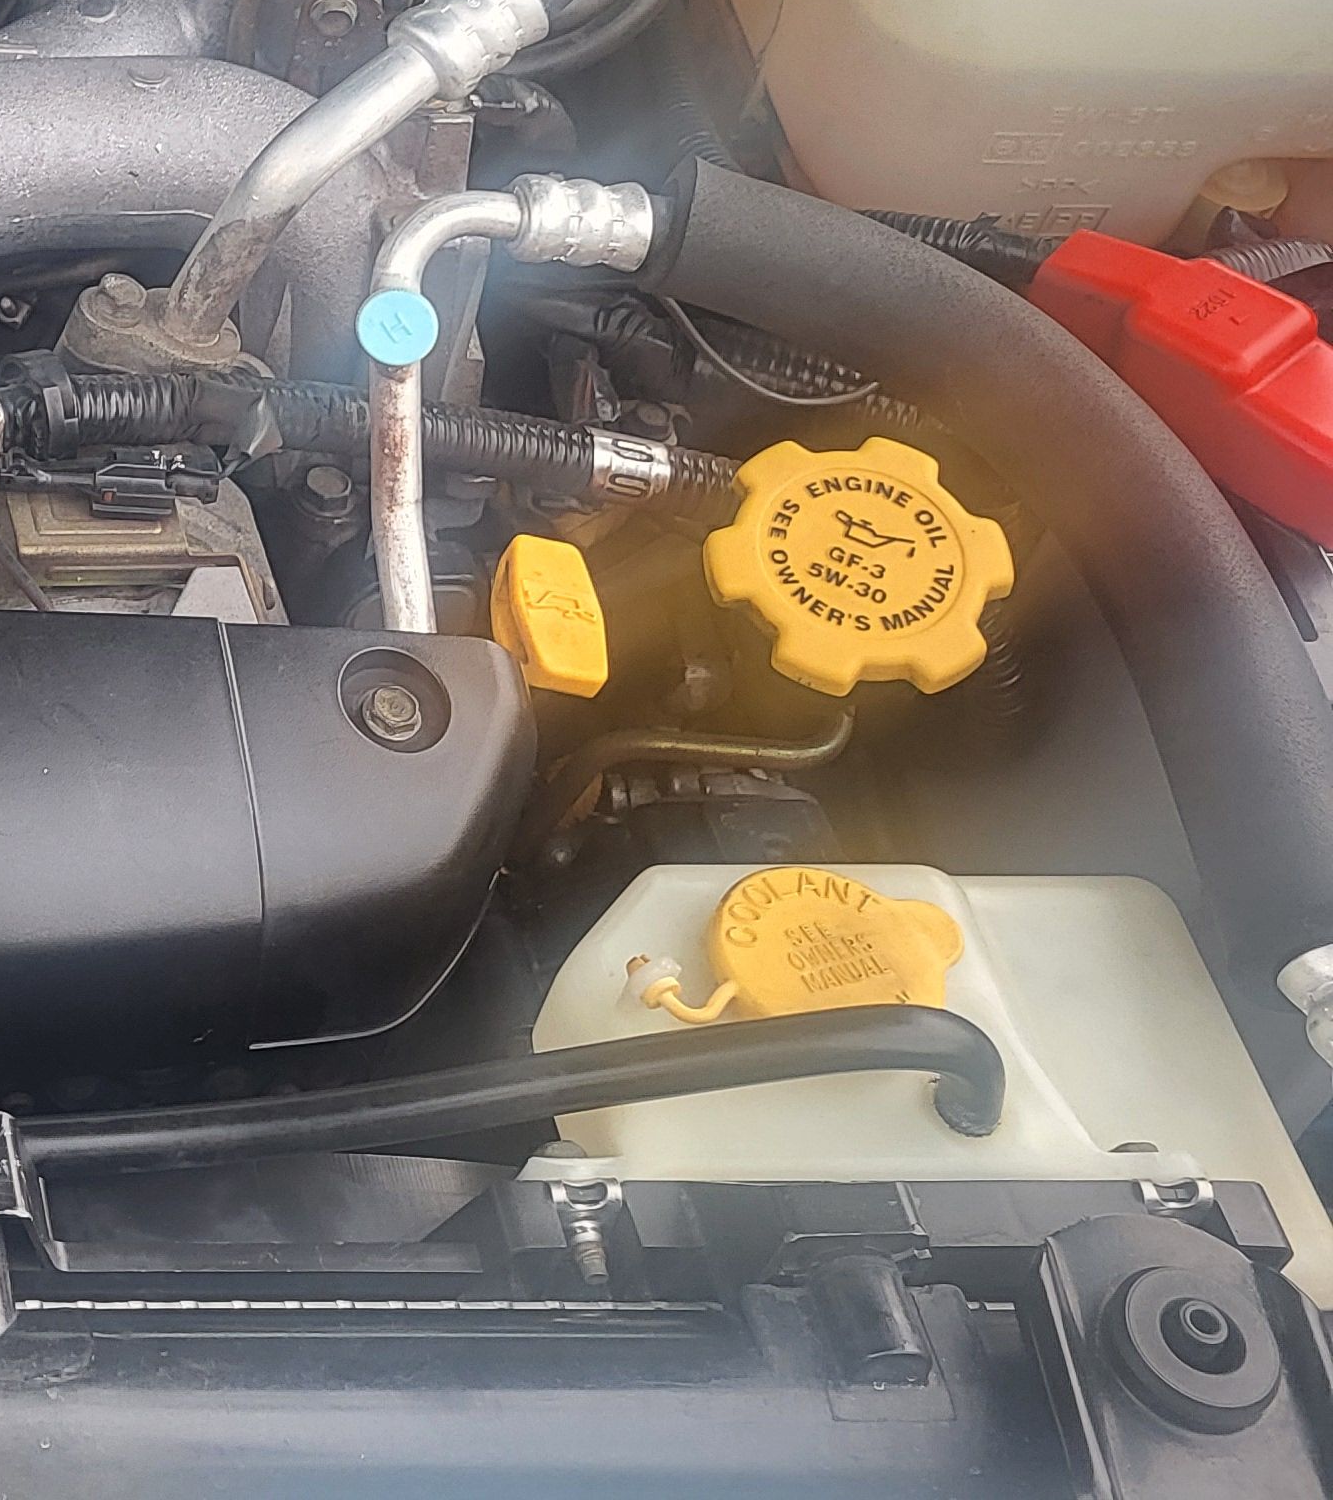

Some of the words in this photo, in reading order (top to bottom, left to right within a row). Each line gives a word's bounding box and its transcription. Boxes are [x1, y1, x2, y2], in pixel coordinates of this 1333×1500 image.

[770, 499, 800, 540] SEE
[806, 476, 913, 508] ENGINE
[914, 510, 947, 548] OIL
[807, 562, 887, 604] 5W-30
[828, 546, 886, 579] GF-3
[771, 550, 871, 631] OWNER'S
[879, 564, 954, 631] MANUAL
[725, 871, 881, 948] COOLANT
[785, 921, 834, 947] SEE
[787, 932, 875, 971] OWNERS
[800, 954, 893, 993] MANUAL
